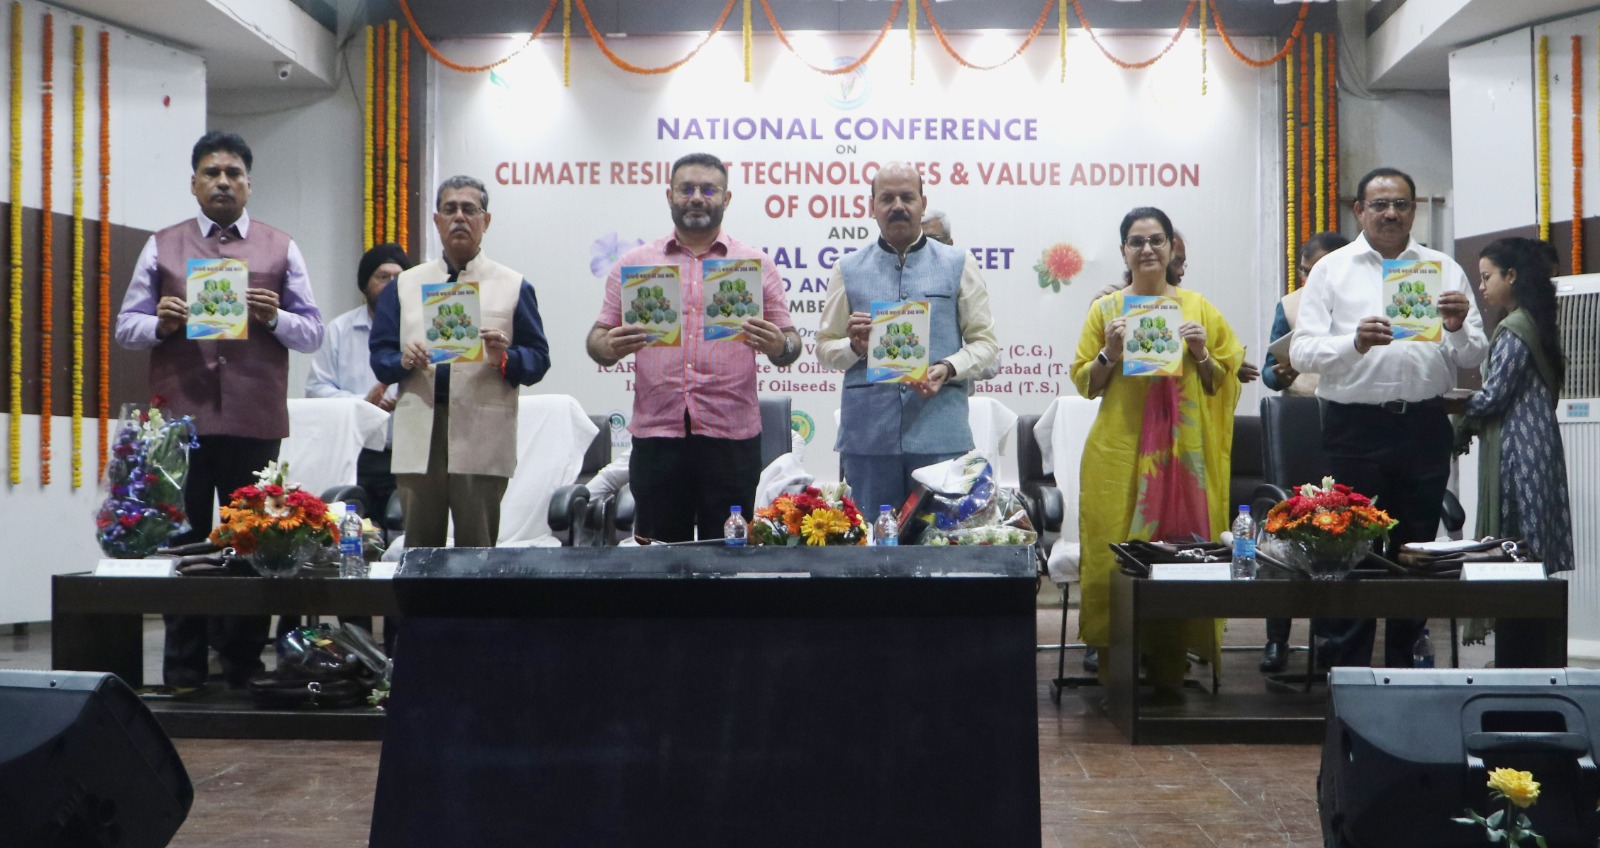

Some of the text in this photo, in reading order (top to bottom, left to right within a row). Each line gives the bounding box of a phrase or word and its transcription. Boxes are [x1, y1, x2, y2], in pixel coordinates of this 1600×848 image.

[657, 117, 1037, 141] NATIONAL CONFERENCE
[835, 144, 857, 154] ON
[495, 161, 1199, 187] CLIMATE RESILT TECHNOLOES & VALUE ADDITION
[765, 194, 799, 218] OF
[828, 227, 869, 239] AND
[1009, 345, 1053, 359] (C.G.)
[769, 380, 836, 392] Oilseeds
[1018, 382, 1060, 396] (T.S.)
